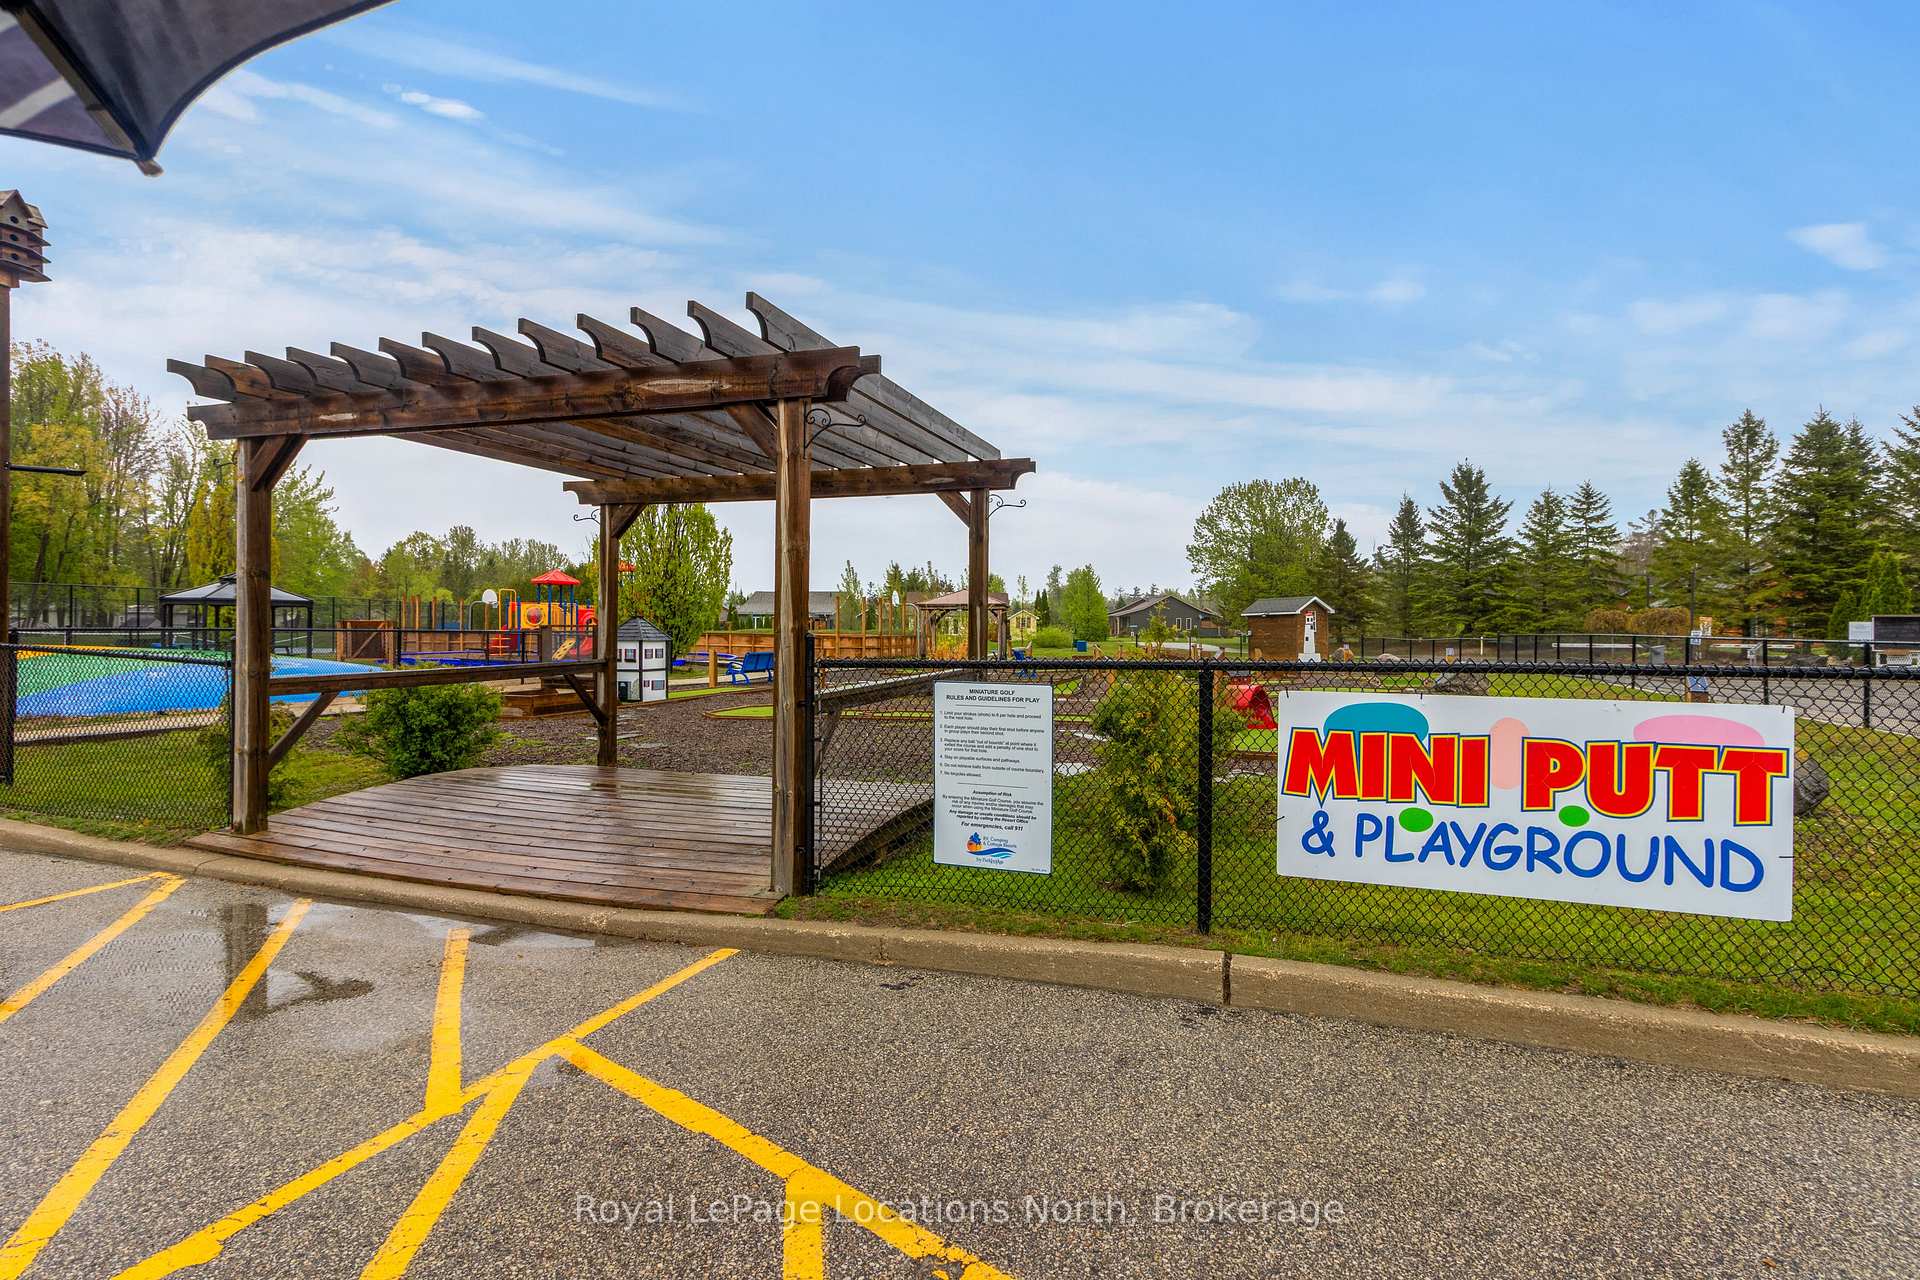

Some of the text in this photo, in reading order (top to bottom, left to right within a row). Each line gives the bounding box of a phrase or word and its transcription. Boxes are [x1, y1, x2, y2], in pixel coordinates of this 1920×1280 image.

[1282, 726, 1789, 826] MINI PUTT
[1302, 810, 1764, 893] & PLAYGROUND
